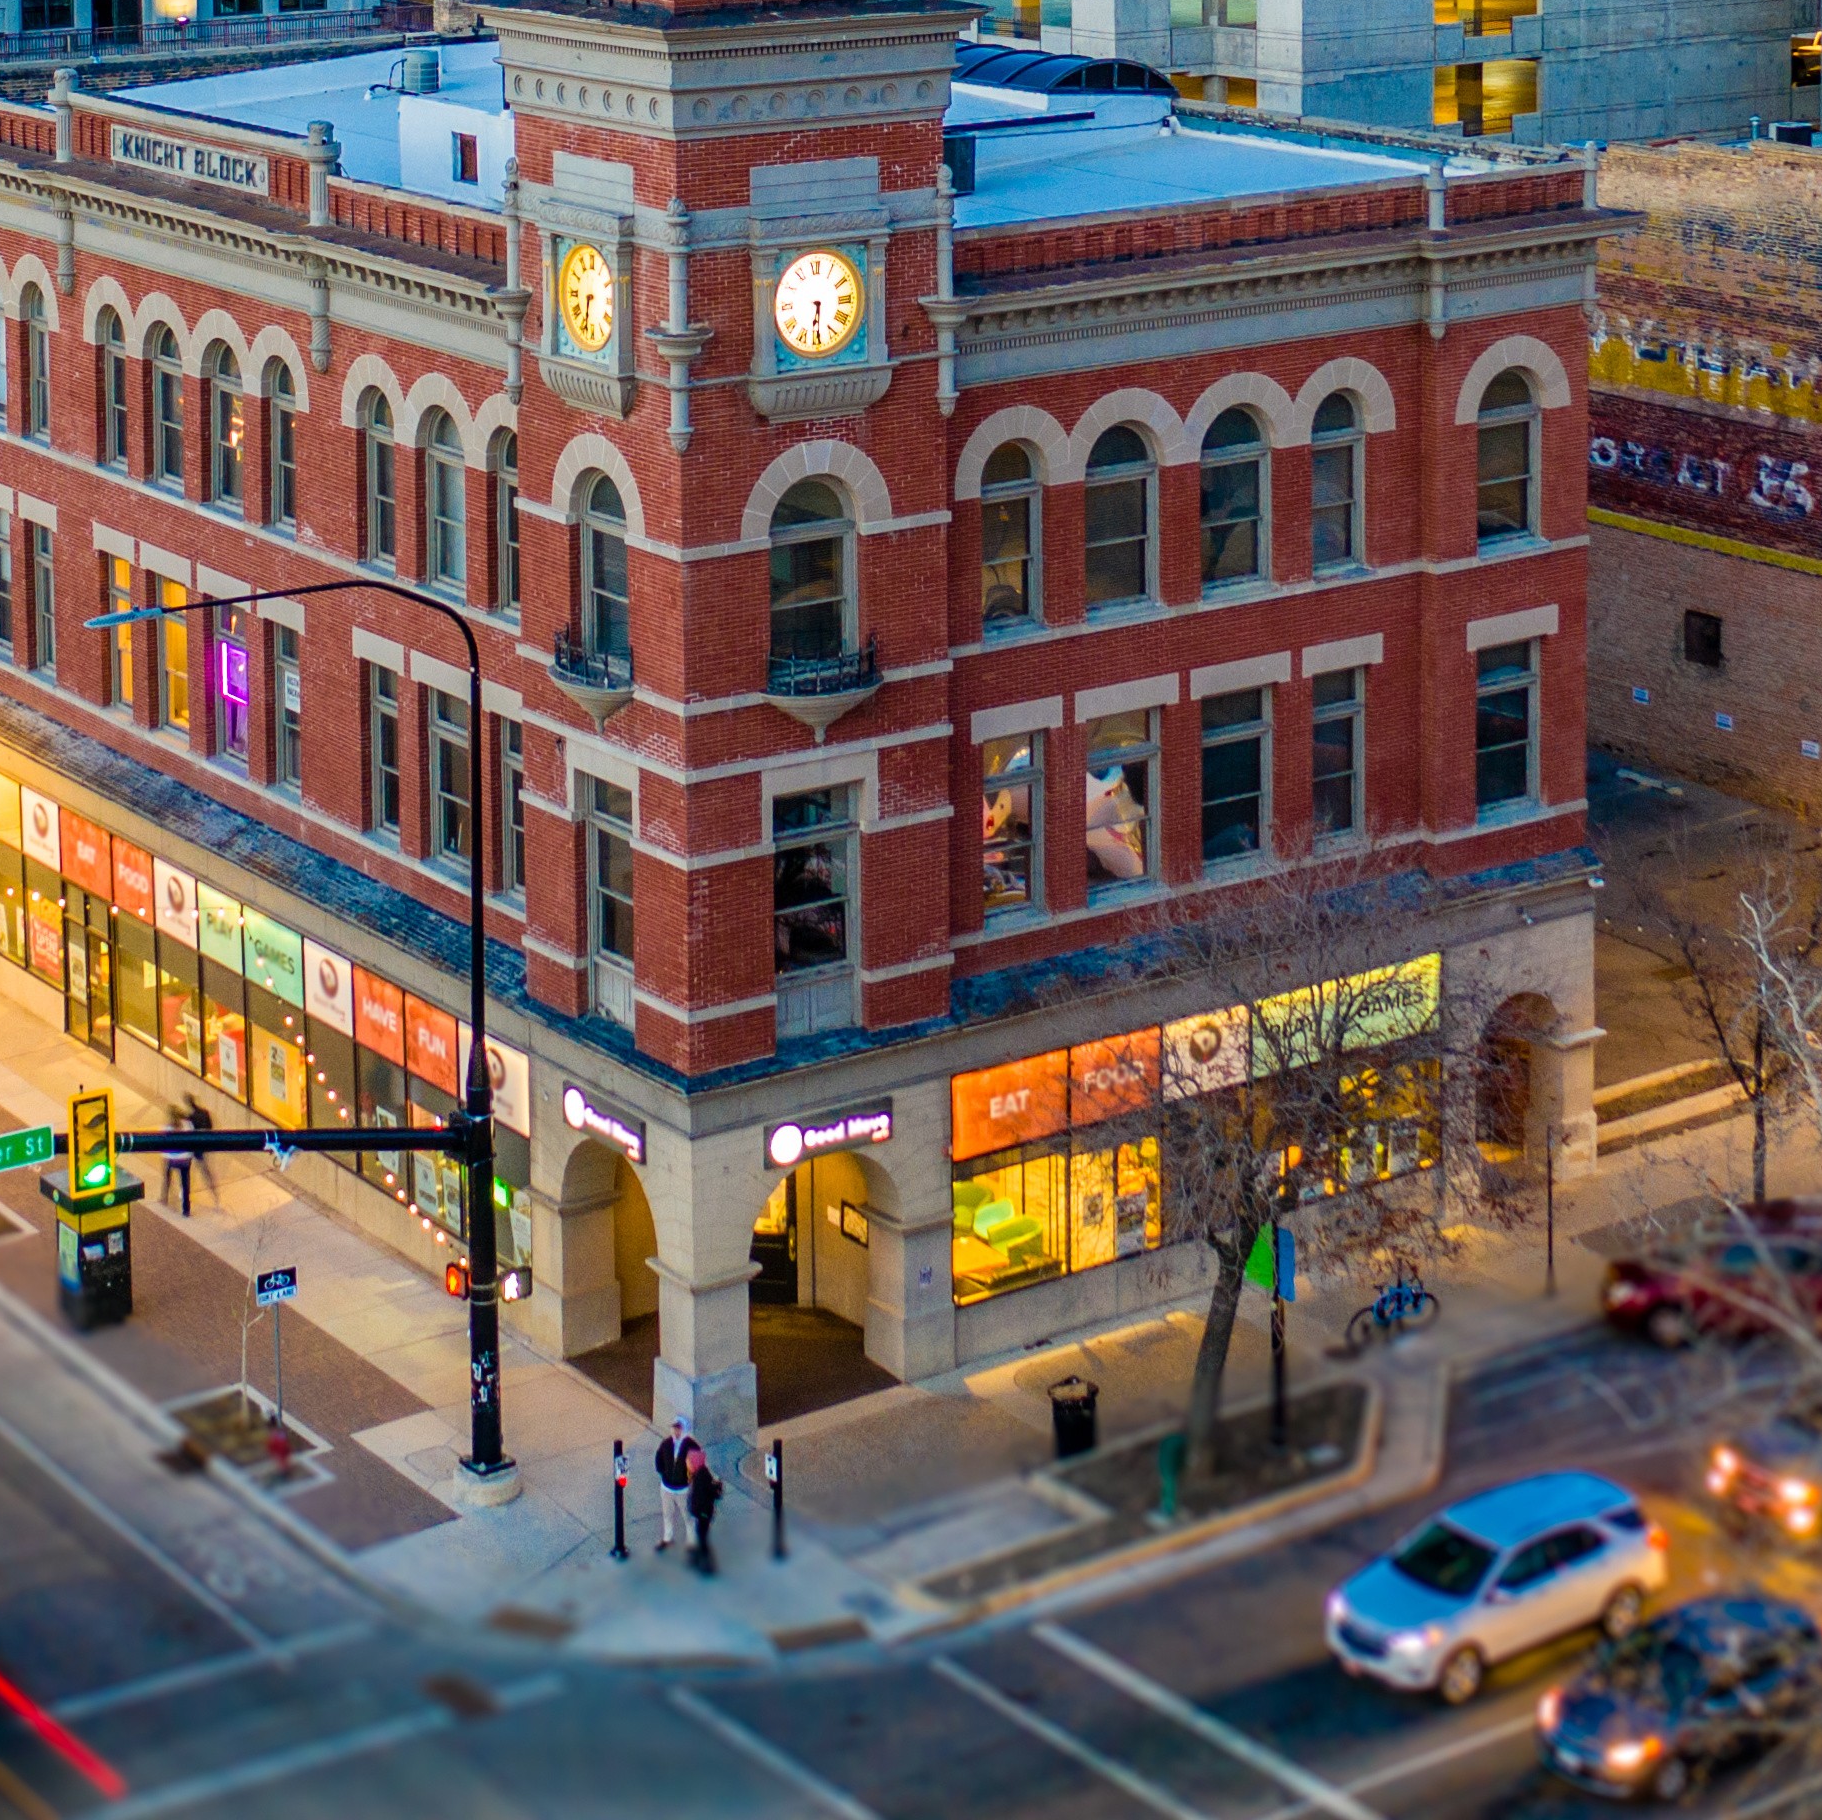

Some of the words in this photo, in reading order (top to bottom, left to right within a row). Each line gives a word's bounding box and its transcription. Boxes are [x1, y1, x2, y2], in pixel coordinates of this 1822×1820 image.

[122, 133, 187, 171] KNIGHT
[193, 148, 259, 188] BLOCK
[117, 863, 150, 895] FOOD
[254, 938, 296, 976] GAMES
[361, 996, 398, 1033] HAVE
[417, 1027, 447, 1060] FUN
[989, 1088, 1030, 1120] EAT
[1083, 1059, 1146, 1095] FOOD
[25, 1134, 44, 1157] St
[803, 1121, 845, 1148] Good
